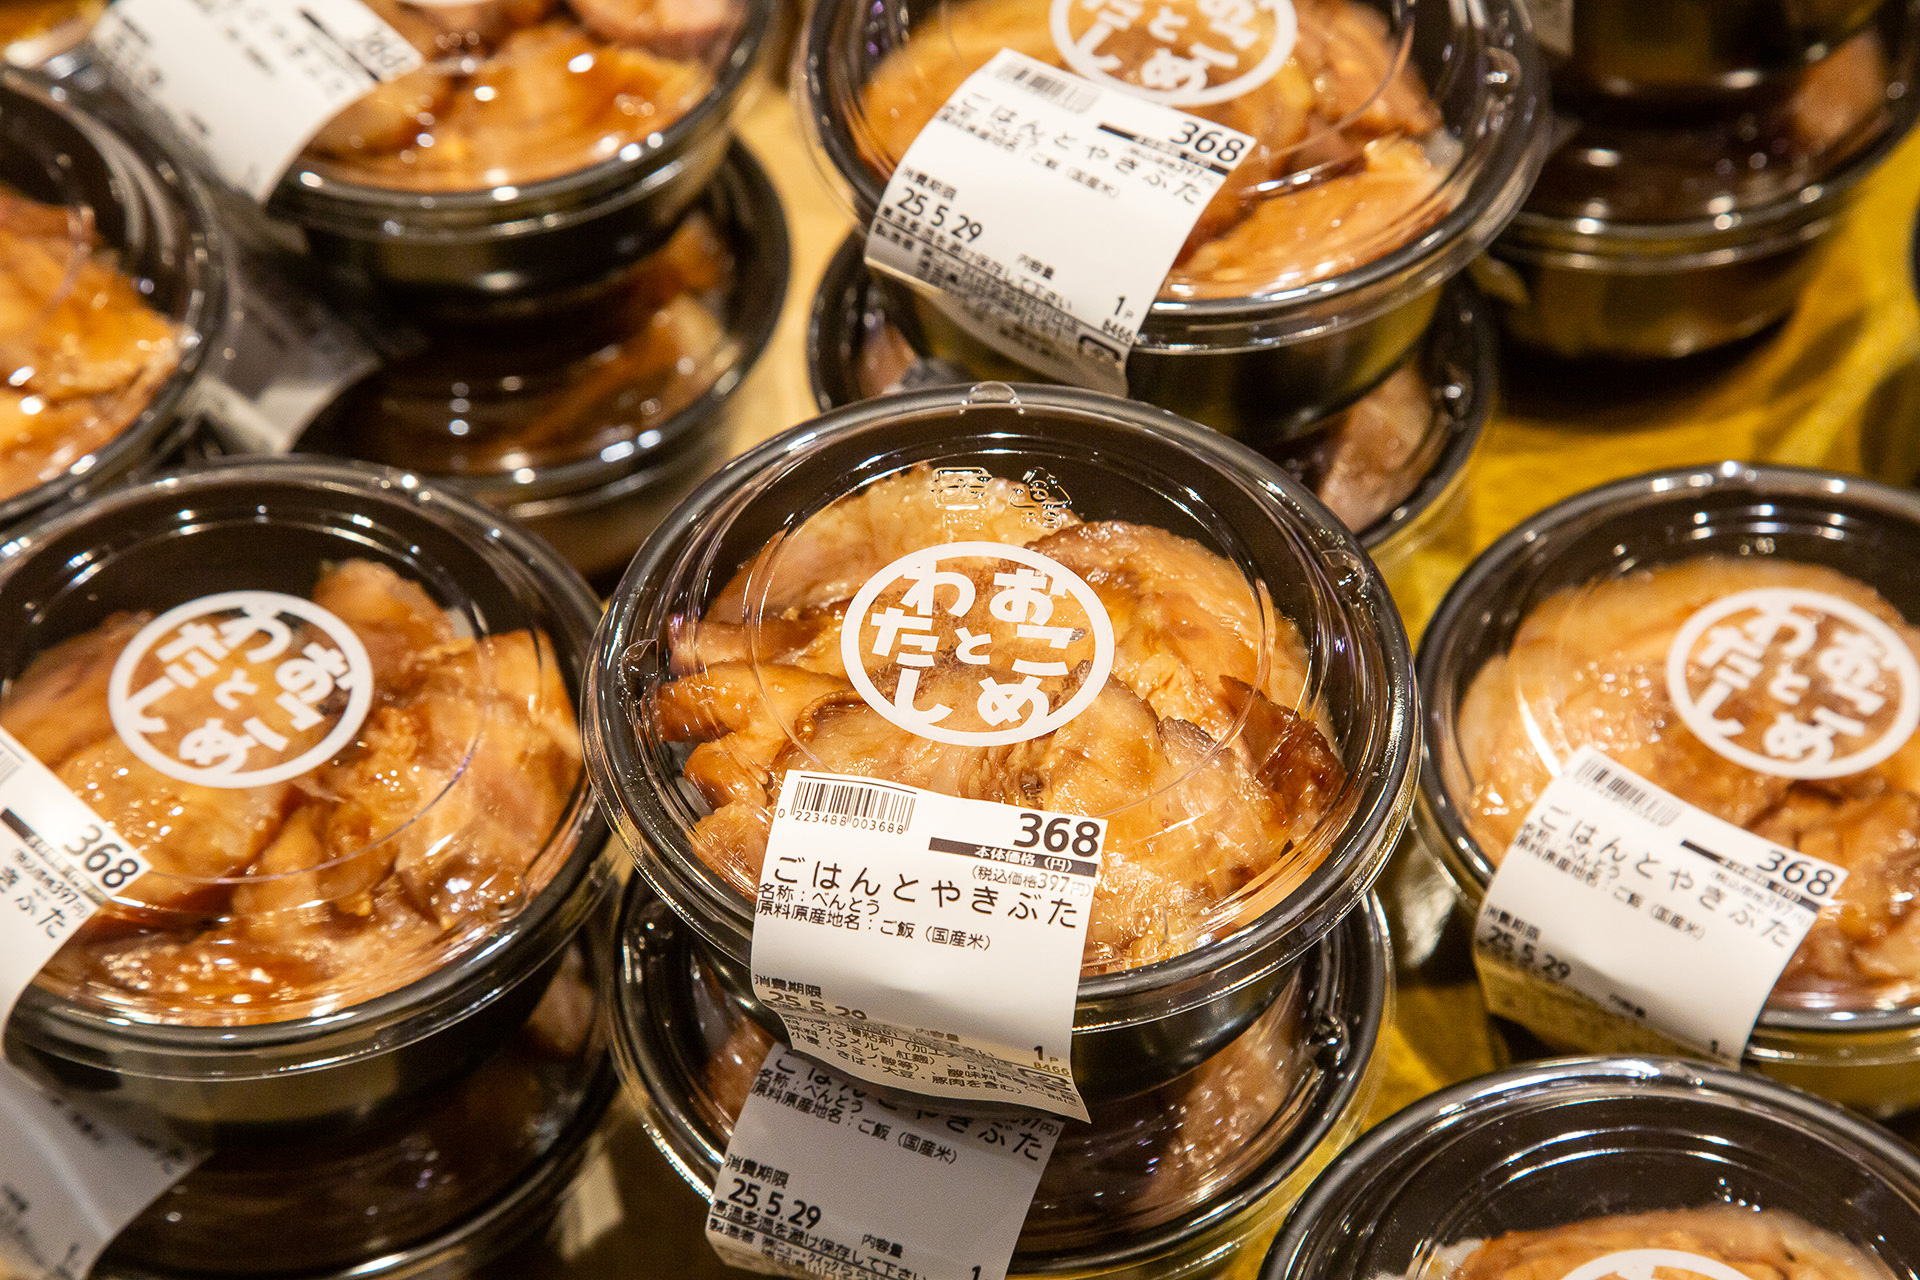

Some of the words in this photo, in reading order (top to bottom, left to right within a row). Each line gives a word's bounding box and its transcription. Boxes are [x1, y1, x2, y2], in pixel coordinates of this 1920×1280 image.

[1149, 6, 1188, 42] と
[1169, 119, 1245, 163] 368
[64, 823, 140, 889] 368
[1013, 812, 1101, 858] 368
[774, 856, 1079, 929] ごはんとやきぶた
[1756, 848, 1837, 898] 368
[754, 974, 823, 999] 消費期限
[725, 1153, 790, 1190] 消費期限
[728, 1177, 822, 1230] 25.5.29
[861, 1233, 904, 1258] 内容量
